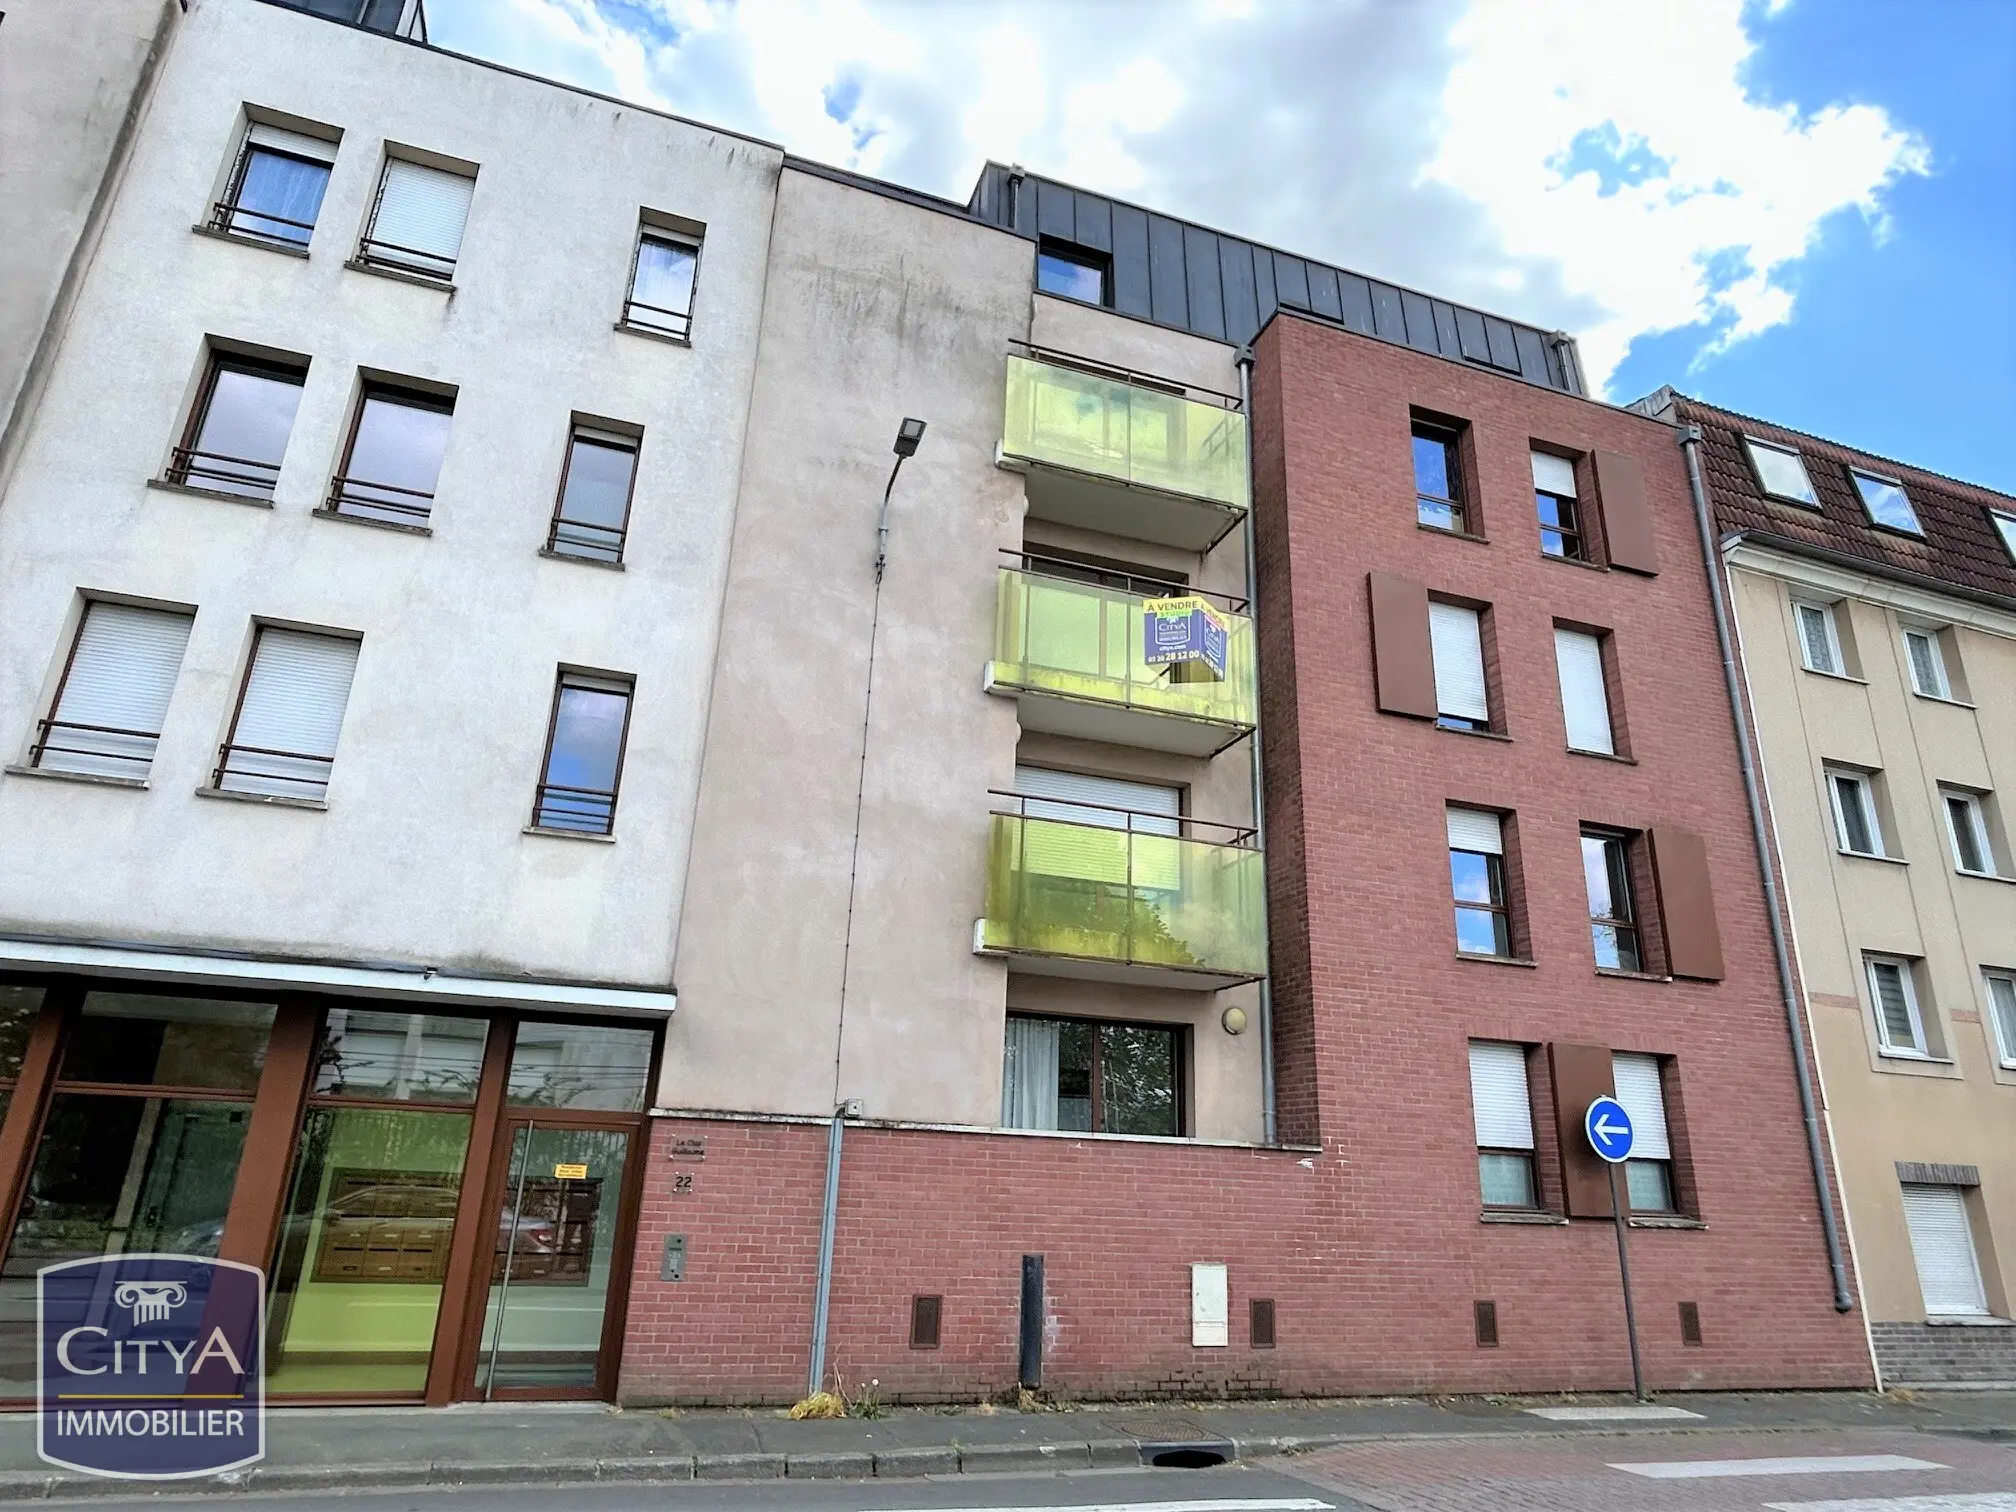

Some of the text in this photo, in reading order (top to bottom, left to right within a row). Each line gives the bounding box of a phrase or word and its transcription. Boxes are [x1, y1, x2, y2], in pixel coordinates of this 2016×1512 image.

[1157, 600, 1198, 611] VENDRE
[1178, 651, 1188, 660] 12
[1189, 650, 1200, 658] 00
[676, 1176, 692, 1188] 22
